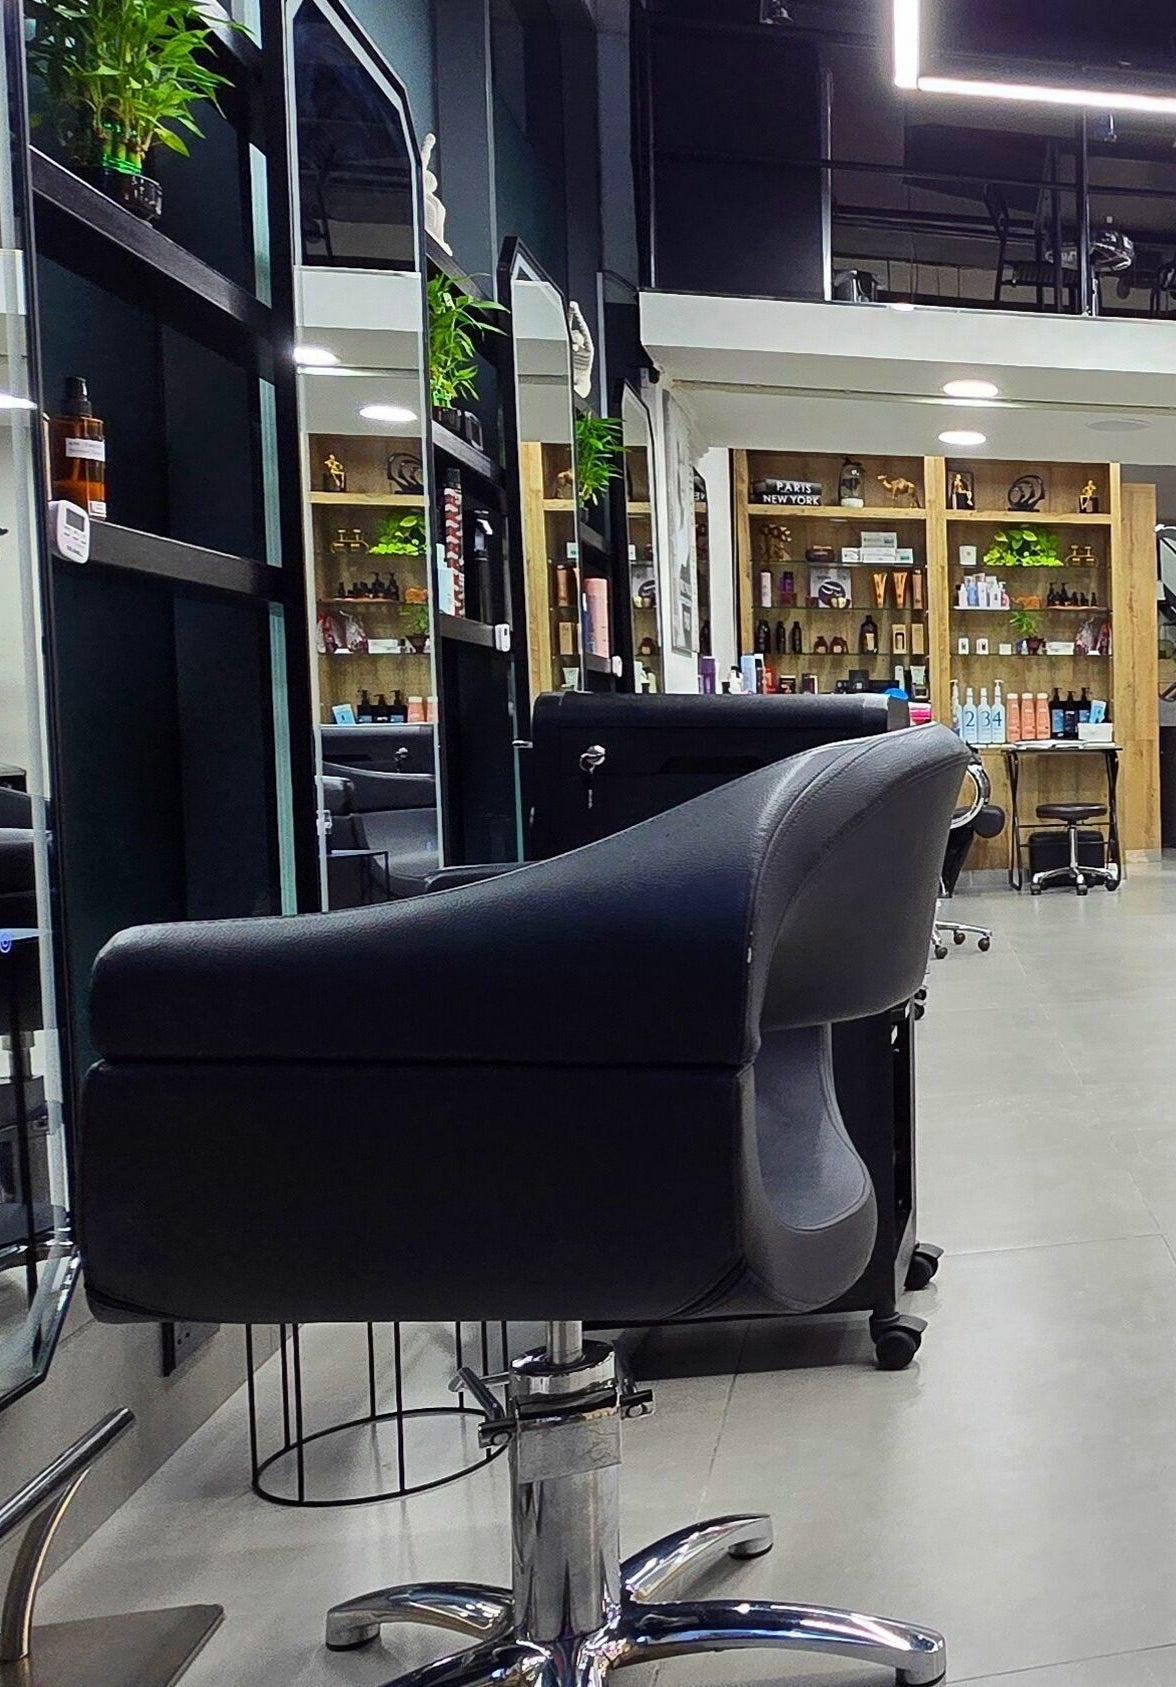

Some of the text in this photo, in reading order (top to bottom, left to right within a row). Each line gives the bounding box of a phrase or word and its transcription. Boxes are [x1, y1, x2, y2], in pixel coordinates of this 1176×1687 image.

[775, 480, 812, 494] PARIS
[763, 494, 820, 506] NEW YORK
[964, 710, 976, 728] 2
[980, 710, 991, 728] 3
[991, 711, 1003, 728] 4
